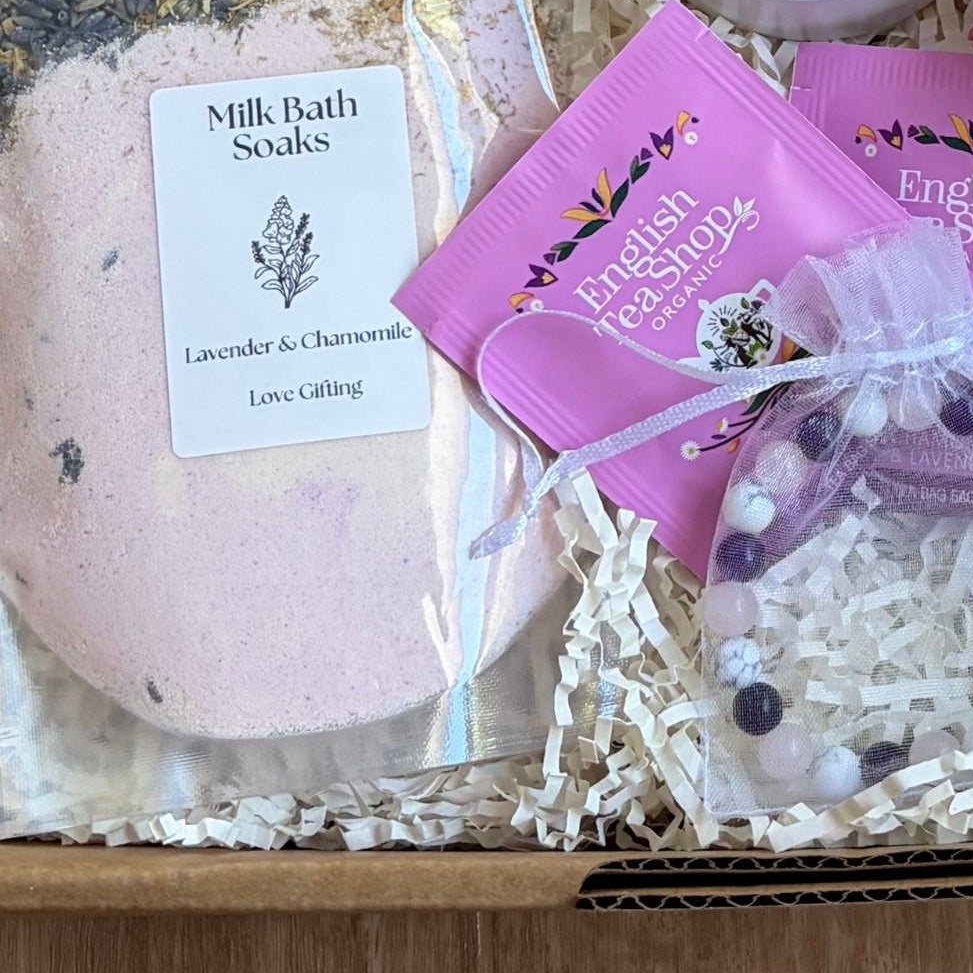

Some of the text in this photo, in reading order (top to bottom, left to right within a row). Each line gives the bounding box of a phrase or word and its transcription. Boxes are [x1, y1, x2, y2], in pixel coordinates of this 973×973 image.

[207, 88, 358, 131] Milk Bath
[232, 126, 331, 160] Soaks
[573, 189, 699, 314] English
[592, 205, 734, 345] Tea Shop
[652, 254, 723, 330] ORGANIC
[185, 322, 413, 364] Lavender & Chamomile
[250, 379, 364, 407] Love Gifting
